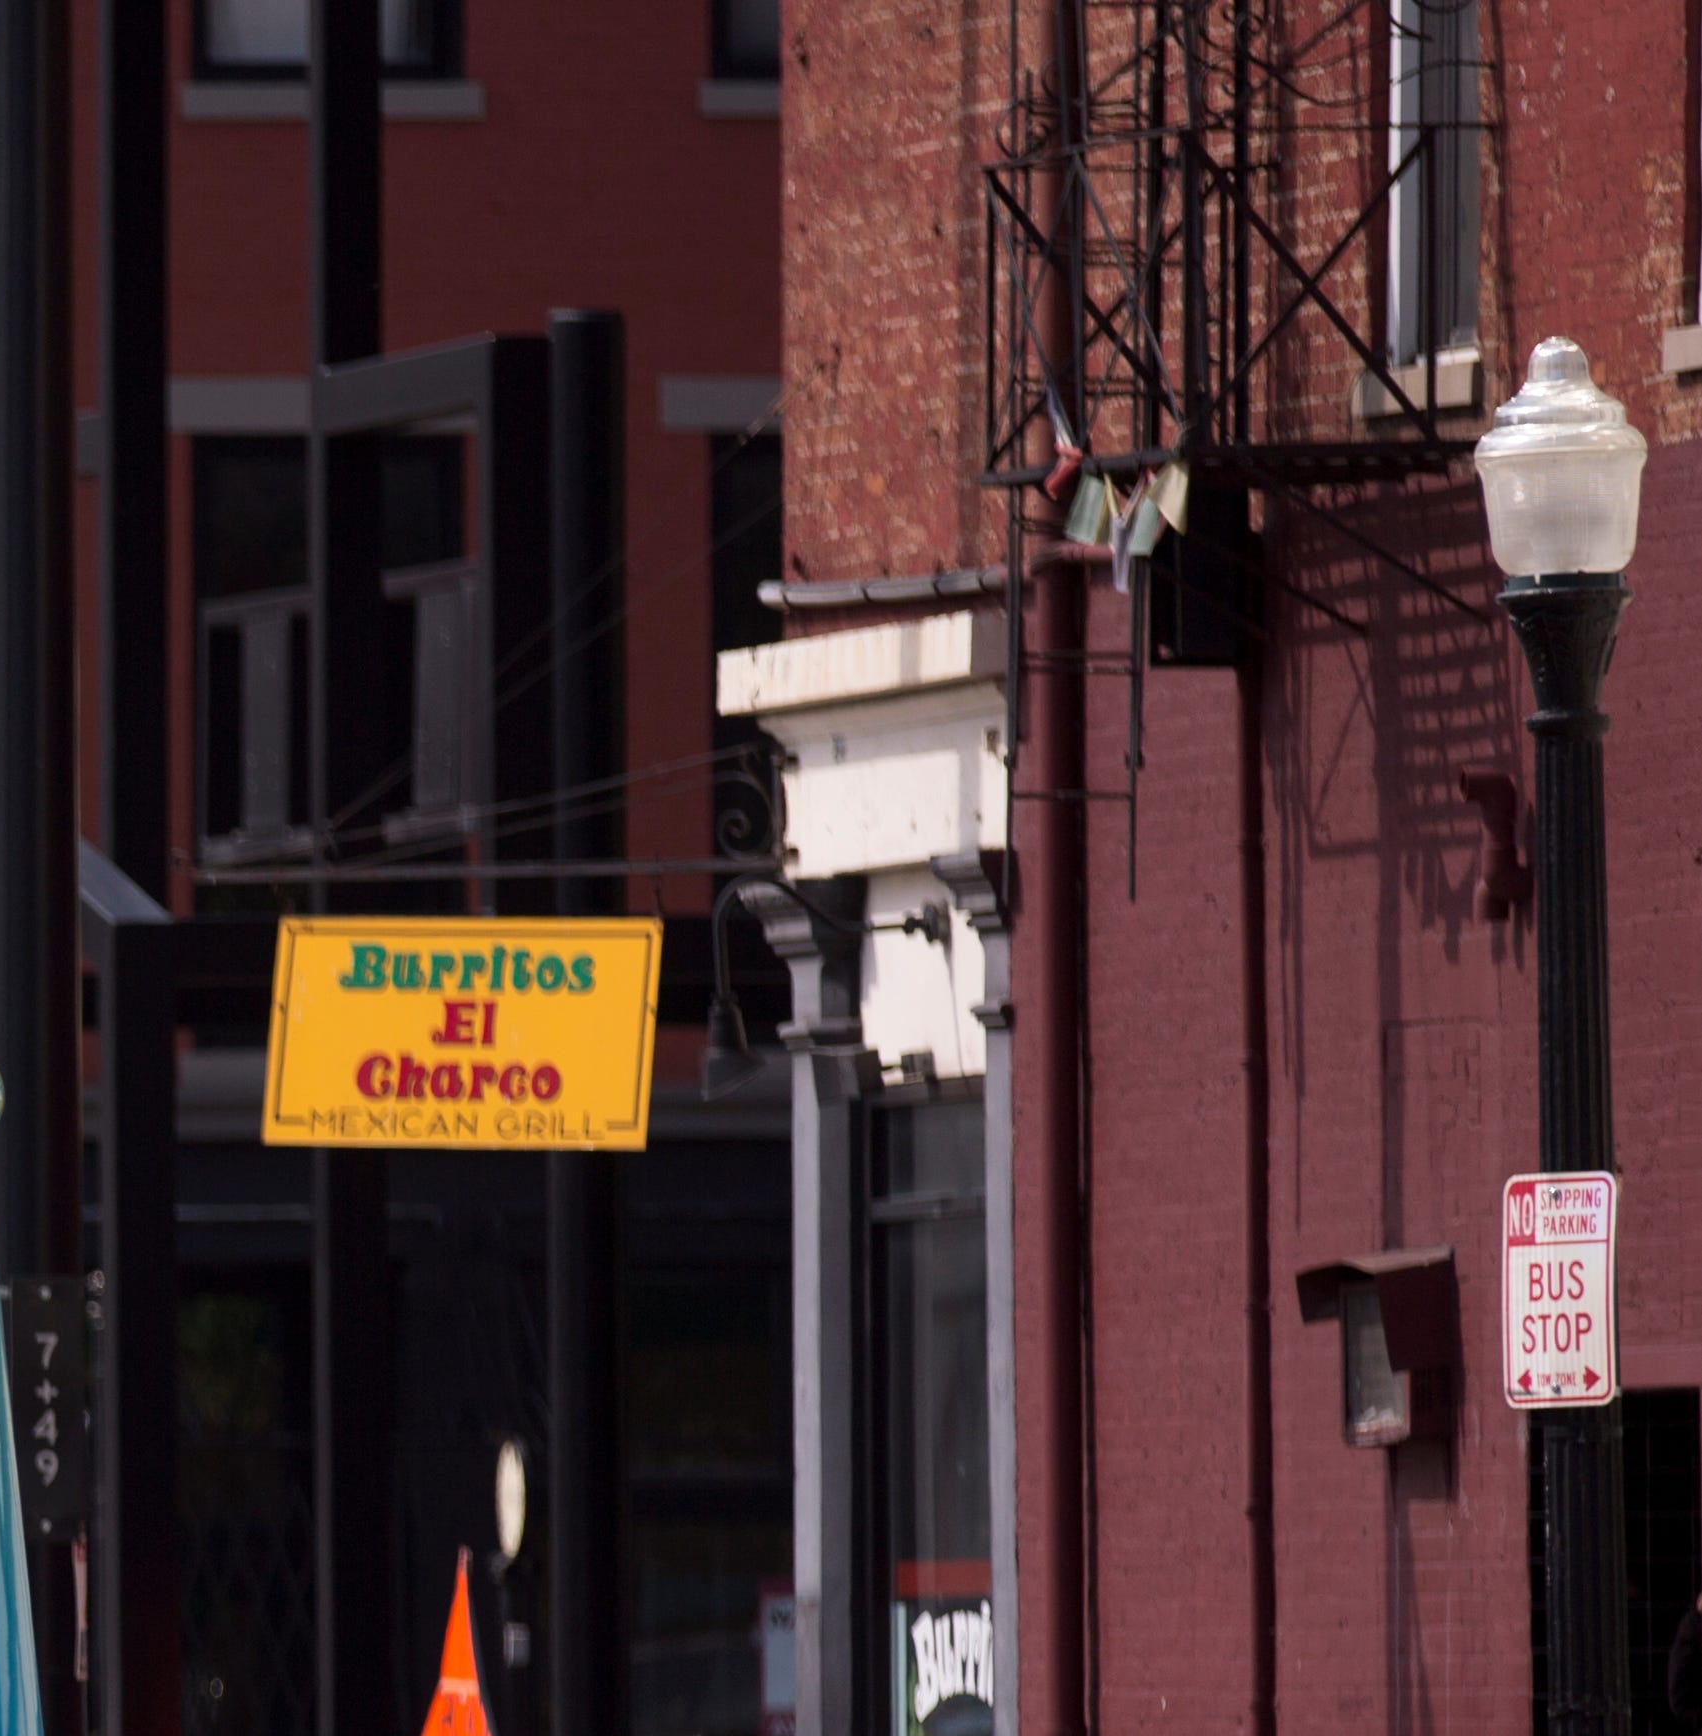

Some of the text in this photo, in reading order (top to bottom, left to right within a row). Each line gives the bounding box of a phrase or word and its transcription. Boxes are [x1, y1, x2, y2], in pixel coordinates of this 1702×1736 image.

[339, 943, 596, 991] Burritos
[431, 1000, 497, 1045] El
[355, 1052, 562, 1101] Charco
[309, 1108, 605, 1142] MEXICAN GRILL
[1508, 1193, 1534, 1237] NO
[1540, 1187, 1602, 1211] STOPPING
[1543, 1213, 1597, 1236] PARKING
[1528, 1260, 1584, 1302] BUS
[1521, 1312, 1592, 1354] STOP
